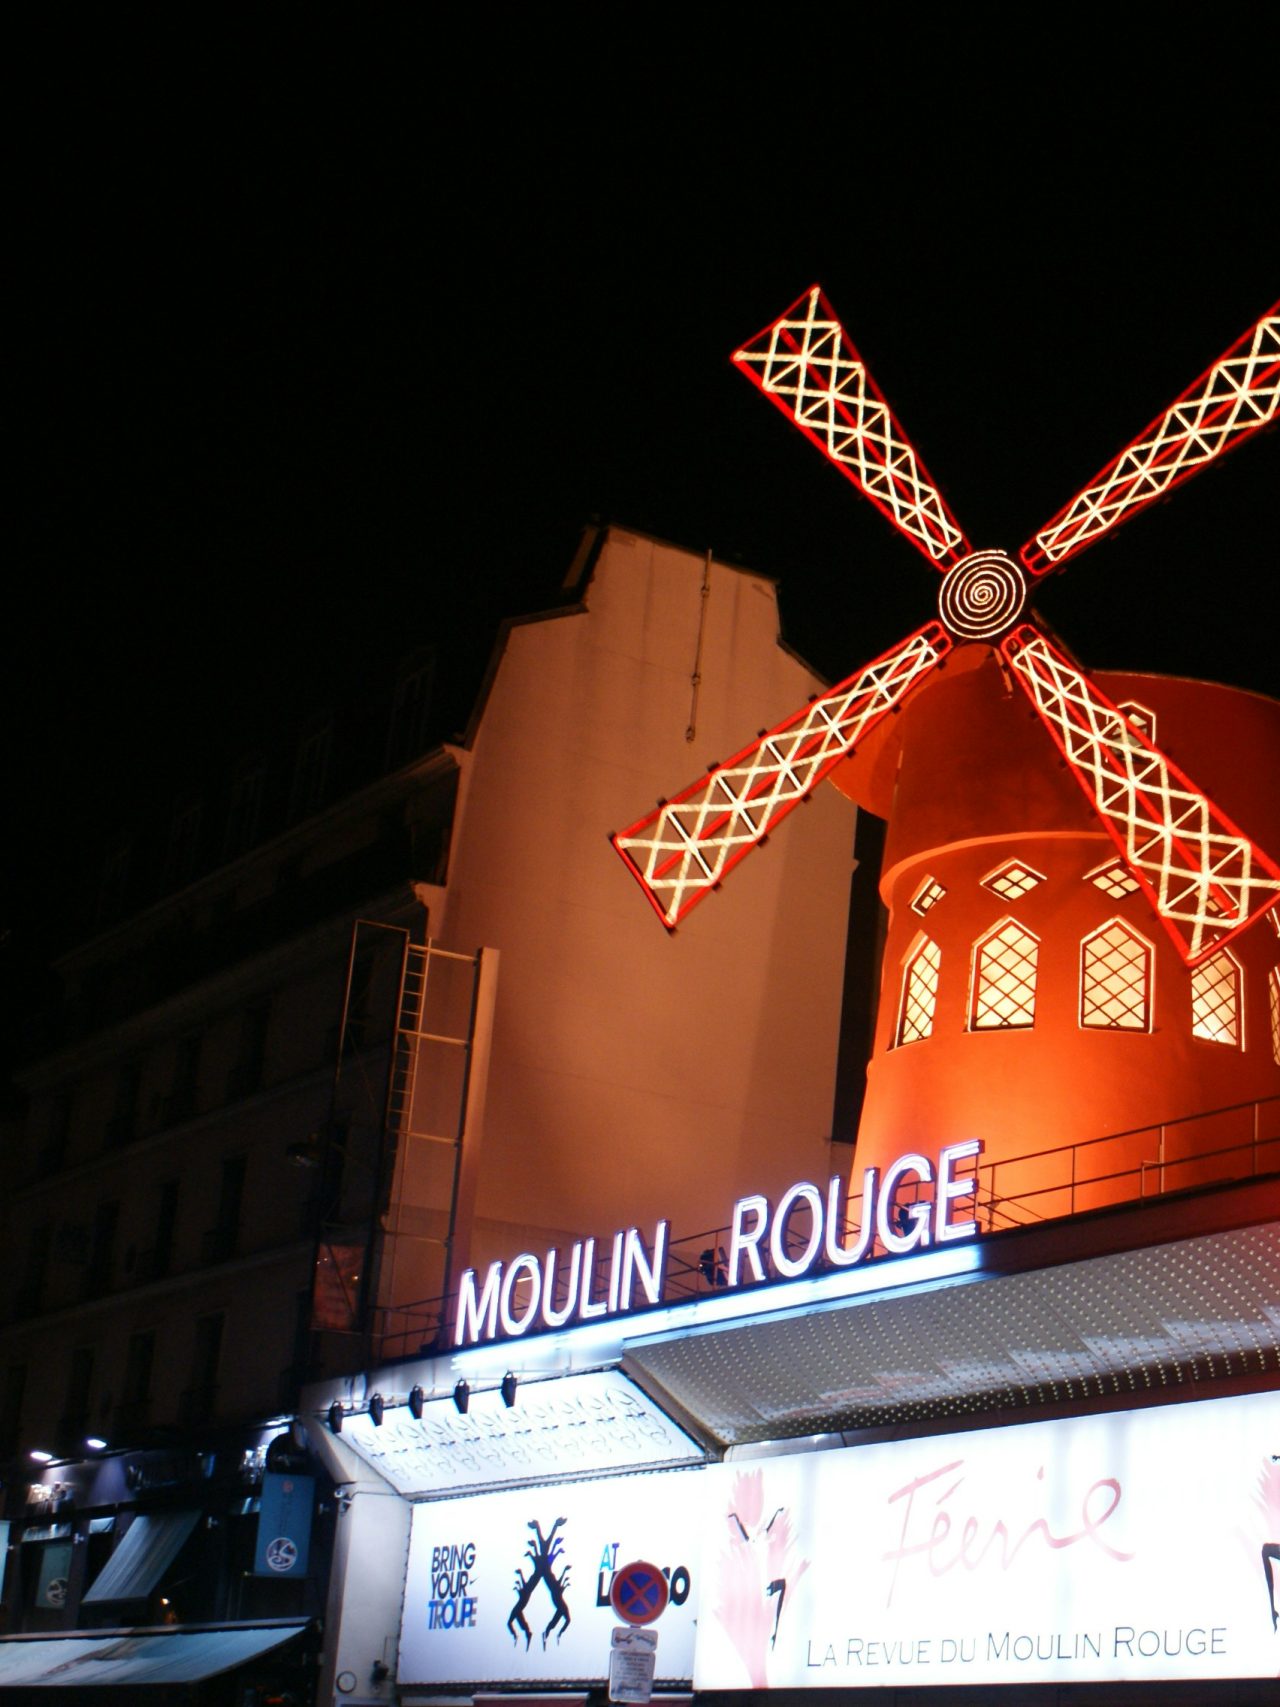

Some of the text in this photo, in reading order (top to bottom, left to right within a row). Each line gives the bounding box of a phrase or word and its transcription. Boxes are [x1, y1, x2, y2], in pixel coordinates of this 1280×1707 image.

[454, 1138, 984, 1346] MOULIN ROUGE
[431, 1542, 476, 1573] BRING
[600, 1542, 620, 1571] AT
[431, 1570, 469, 1600] YOUR
[428, 1597, 479, 1630] TROUPE
[806, 1626, 1228, 1668] LA REVUE DU MOULIN ROUGE
